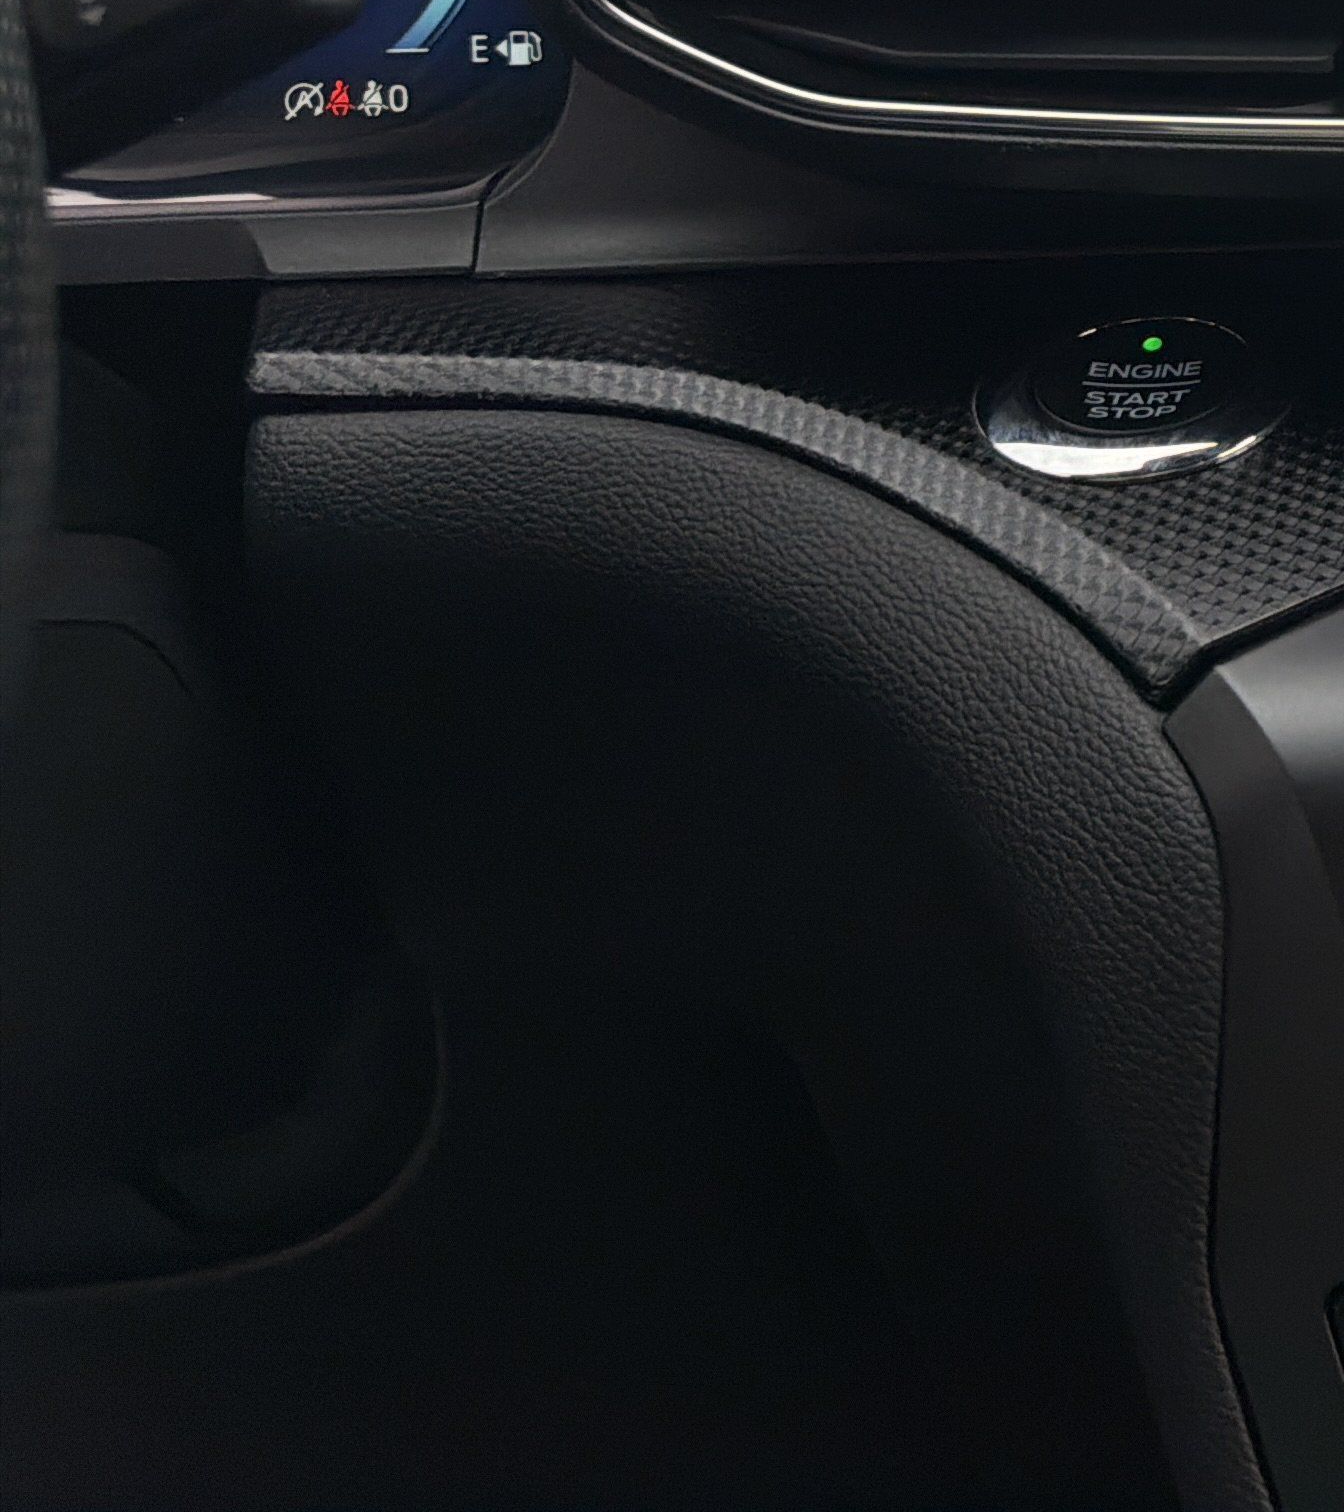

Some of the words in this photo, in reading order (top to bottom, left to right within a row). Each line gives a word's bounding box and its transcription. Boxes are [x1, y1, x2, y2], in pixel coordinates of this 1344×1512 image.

[470, 34, 490, 64] E
[1087, 359, 1203, 380] ENGINE
[1083, 387, 1192, 406] START
[1086, 403, 1178, 420] STOP
